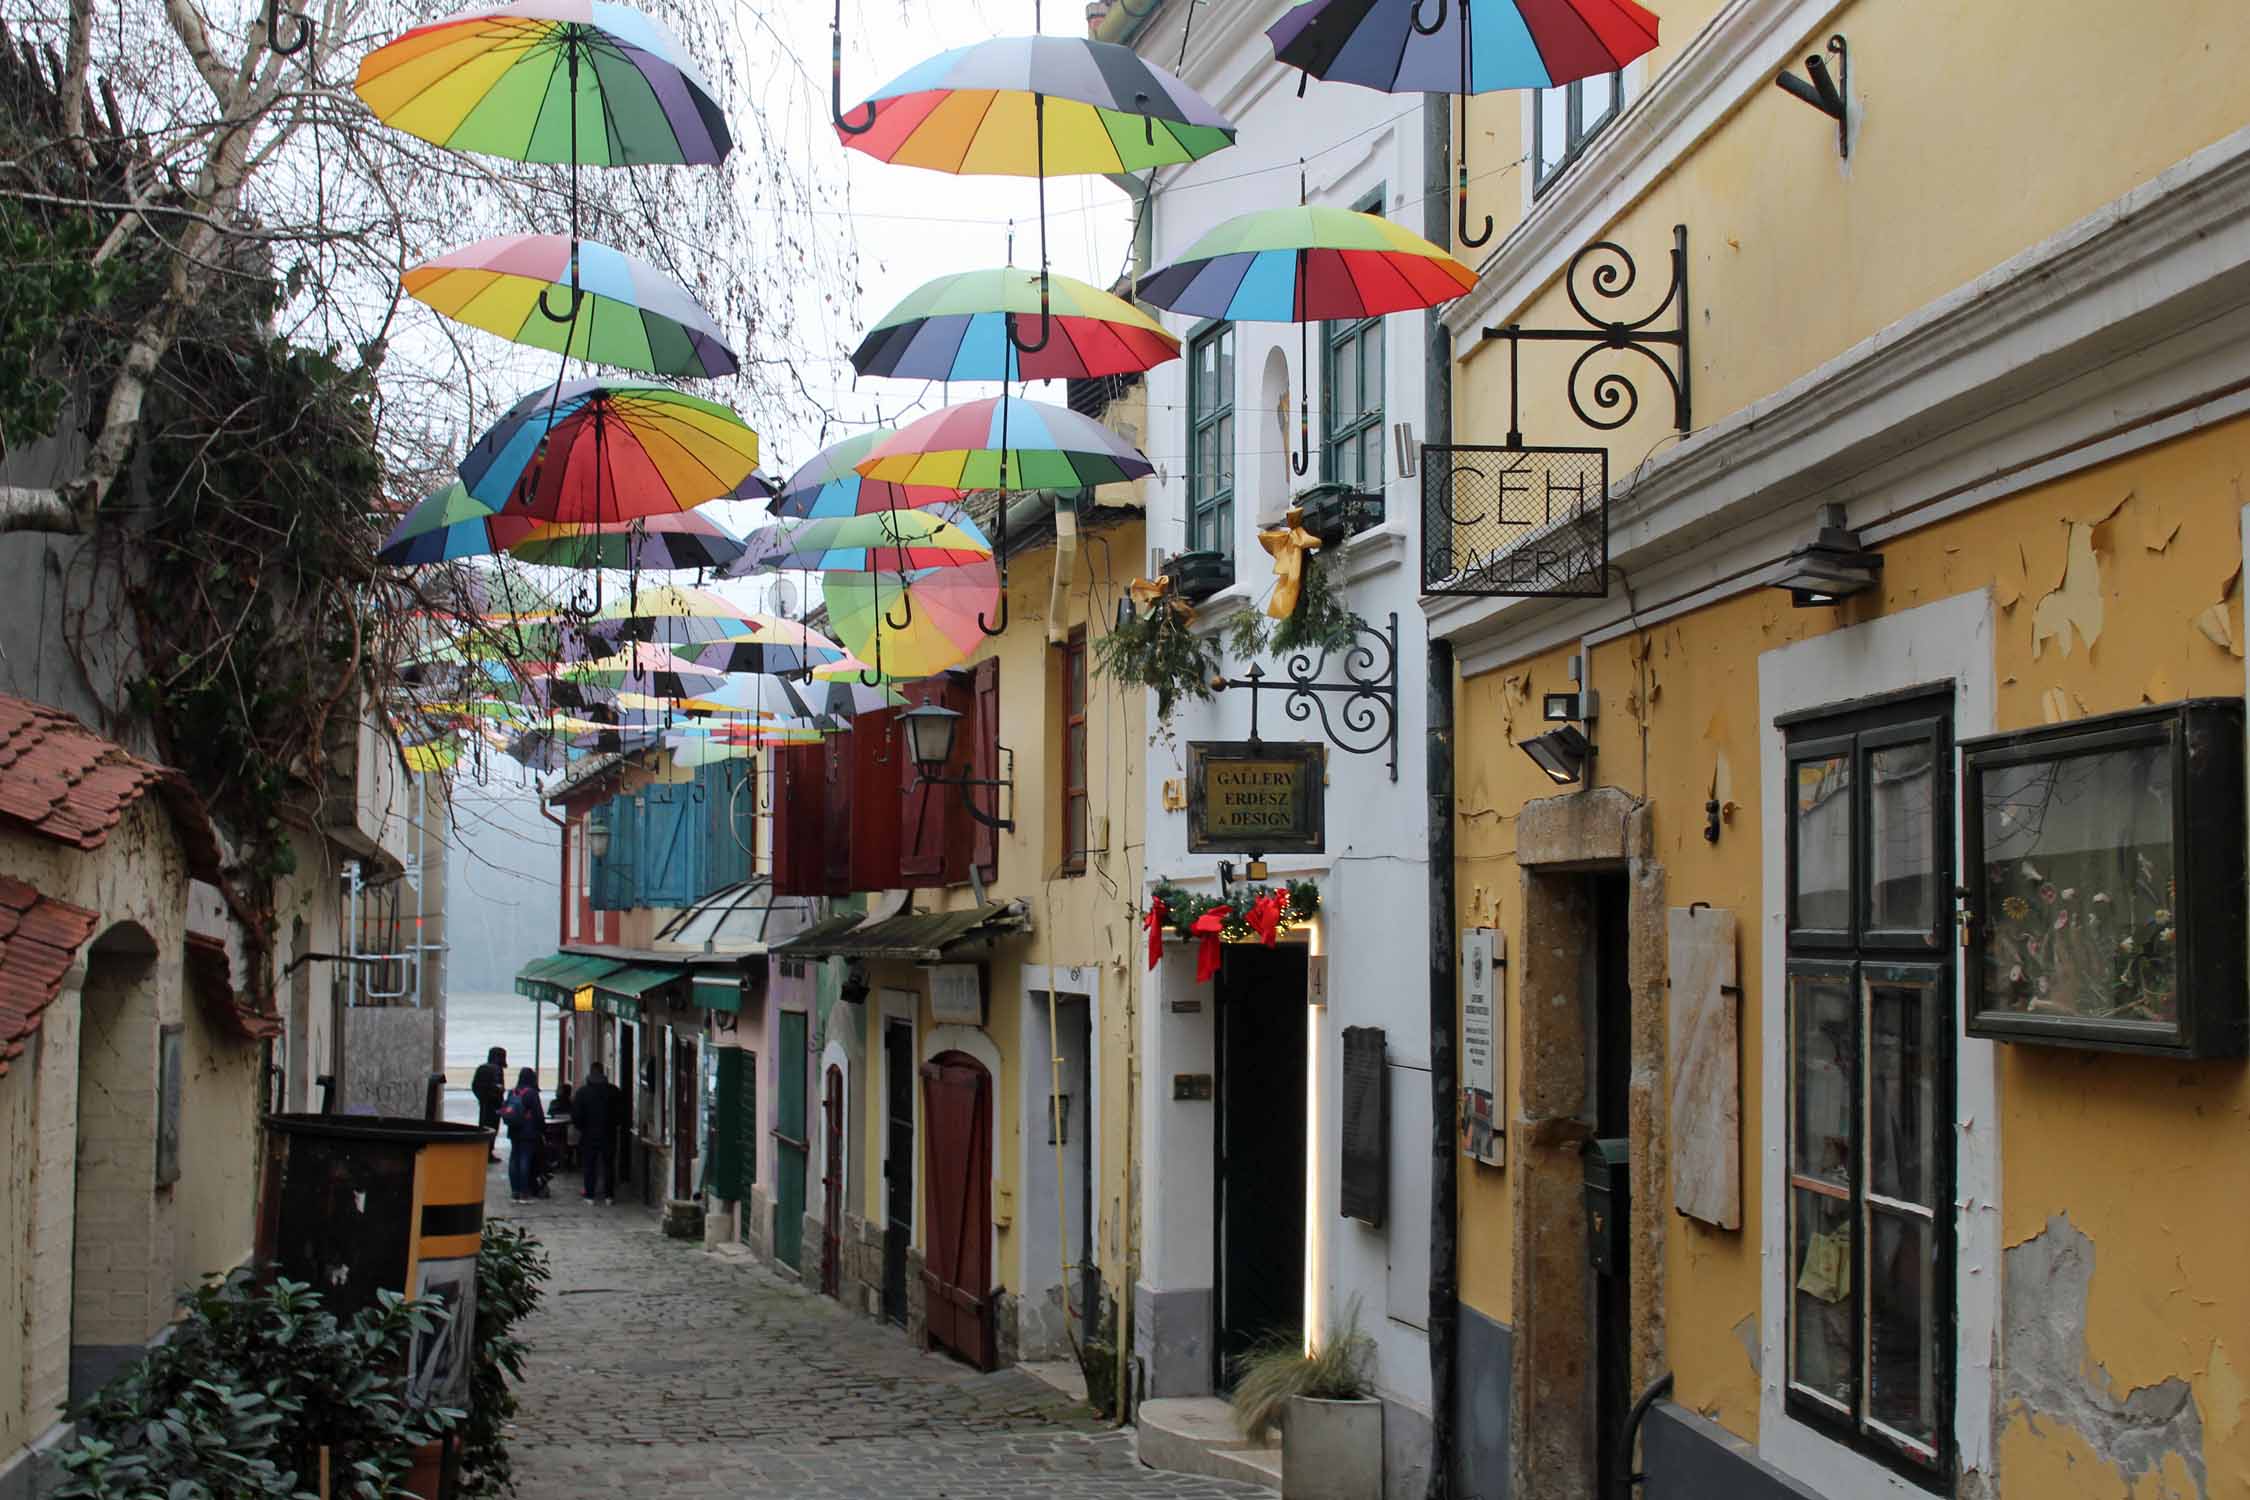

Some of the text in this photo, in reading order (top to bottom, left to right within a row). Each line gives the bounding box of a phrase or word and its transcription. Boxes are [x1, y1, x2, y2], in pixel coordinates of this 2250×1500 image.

[1439, 451, 1584, 525] CÉH
[1429, 539, 1600, 585] GALÉRIA
[1218, 771, 1294, 785] GALLERY
[1232, 813, 1290, 825] DESIGN
